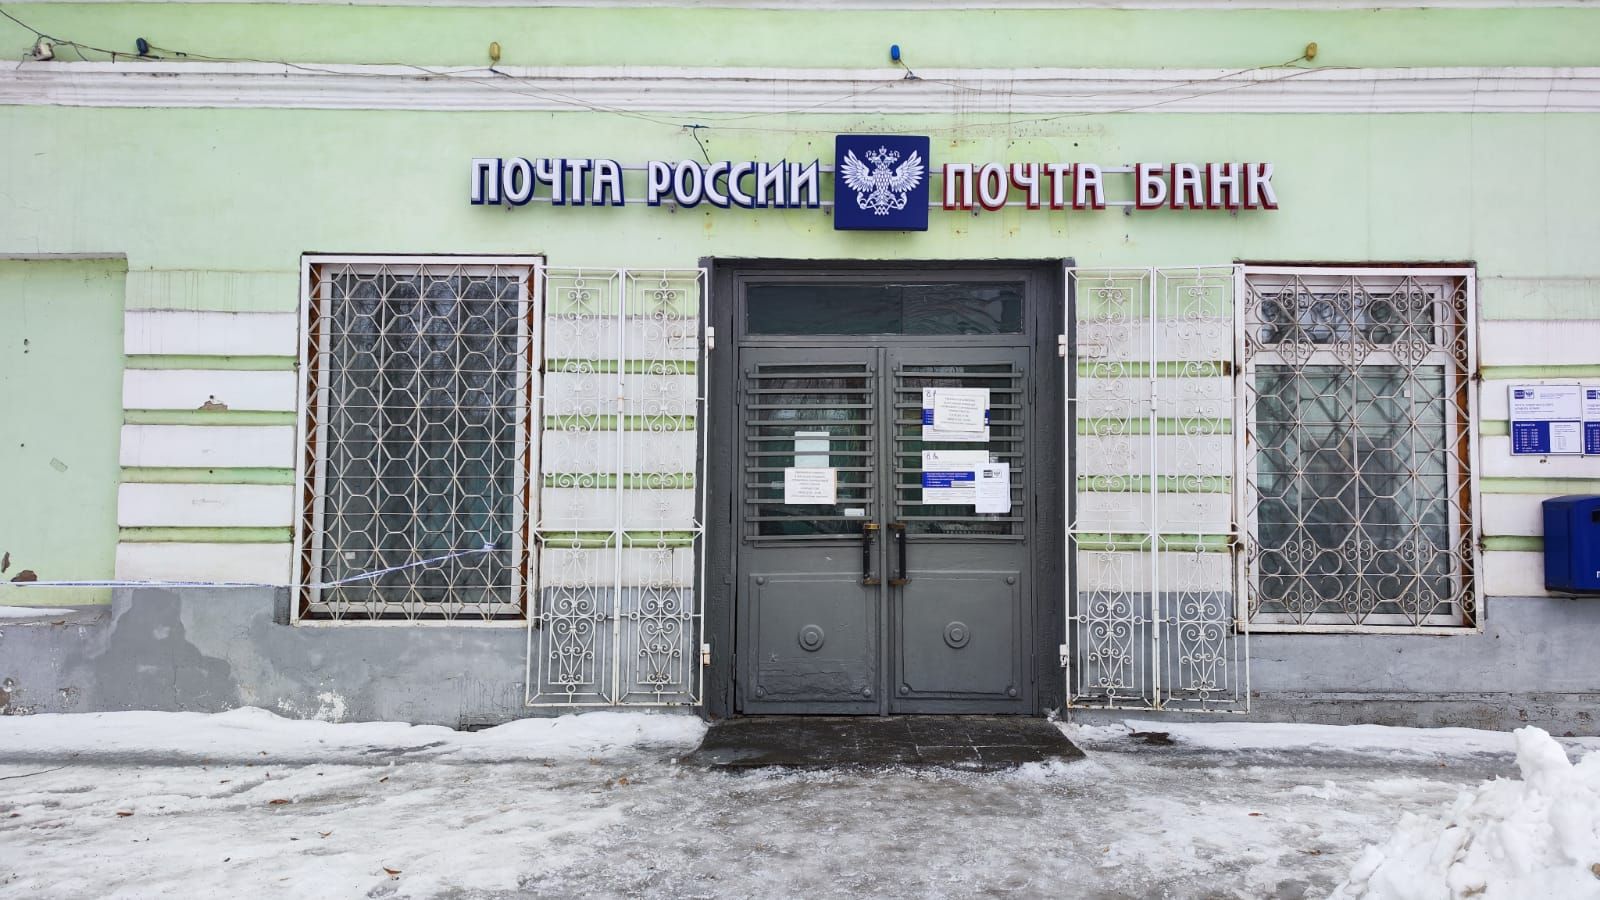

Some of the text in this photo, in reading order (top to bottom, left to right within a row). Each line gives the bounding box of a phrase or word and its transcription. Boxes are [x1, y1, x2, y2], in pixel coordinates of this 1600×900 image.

[470, 157, 820, 208] ПОЧТА РОССИИ
[942, 162, 1279, 211] ПОЧТА БАНК
